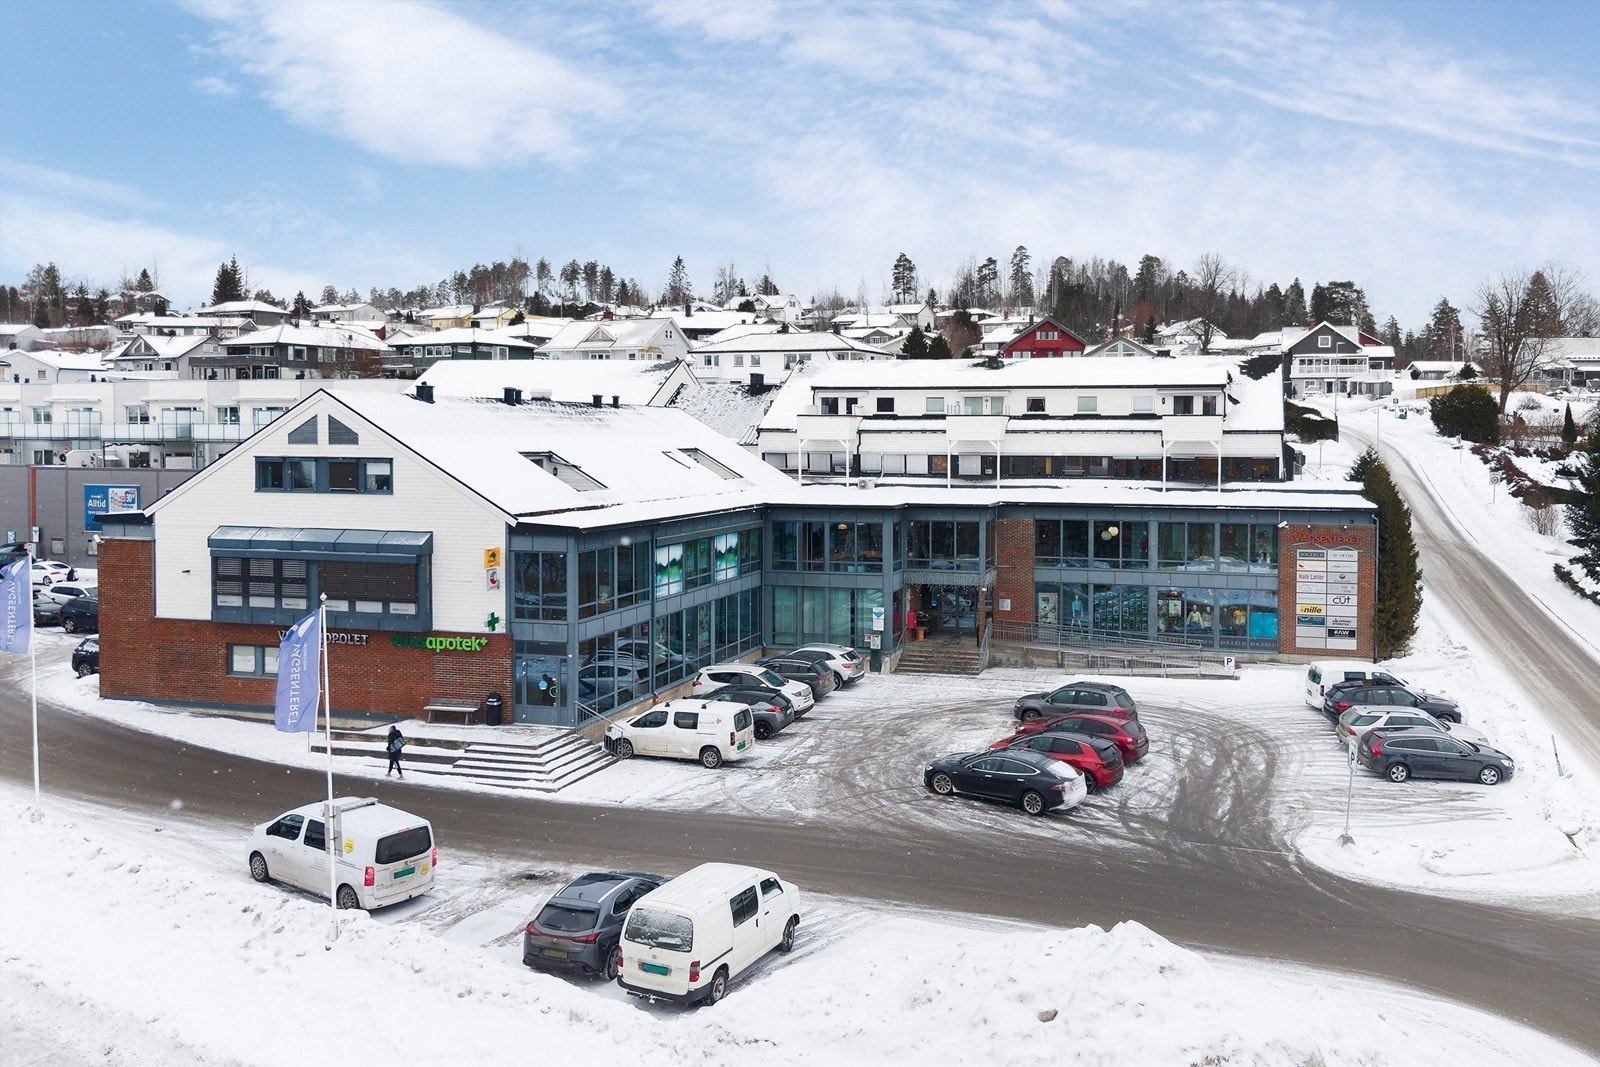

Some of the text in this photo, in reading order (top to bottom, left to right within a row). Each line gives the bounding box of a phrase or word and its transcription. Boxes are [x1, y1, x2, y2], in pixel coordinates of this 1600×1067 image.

[88, 499, 106, 508] Alltid
[277, 630, 368, 645] VOPOLET
[1226, 657, 1233, 666] P
